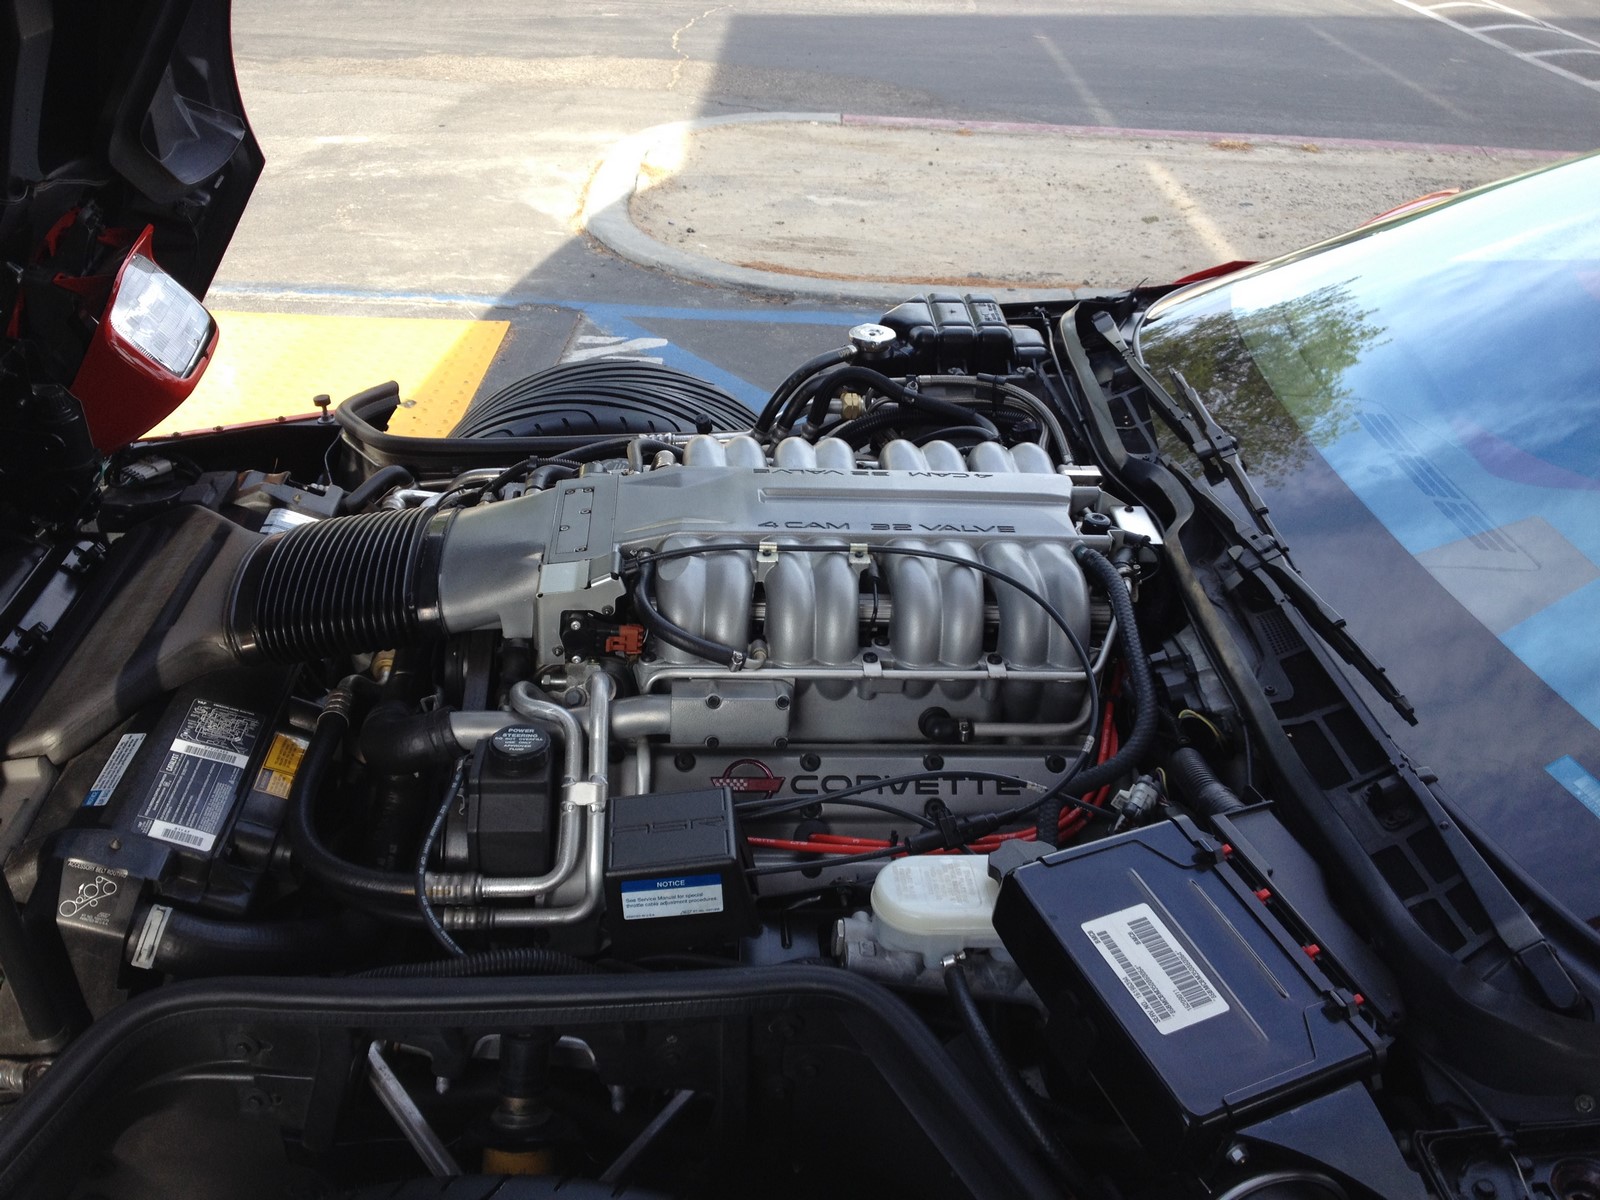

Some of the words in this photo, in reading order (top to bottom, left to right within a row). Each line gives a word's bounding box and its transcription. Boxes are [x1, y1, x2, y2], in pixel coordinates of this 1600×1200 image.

[752, 468, 845, 476] VALVE
[758, 520, 780, 529] 4
[784, 520, 851, 531] CAM
[870, 522, 914, 532] 32
[918, 523, 1017, 534] VALVE
[789, 774, 1022, 796] CORVETTE
[68, 861, 95, 872] ACCESSORY
[95, 866, 107, 874] BELT
[656, 879, 686, 888] NOTICE
[659, 899, 688, 908] adjustment
